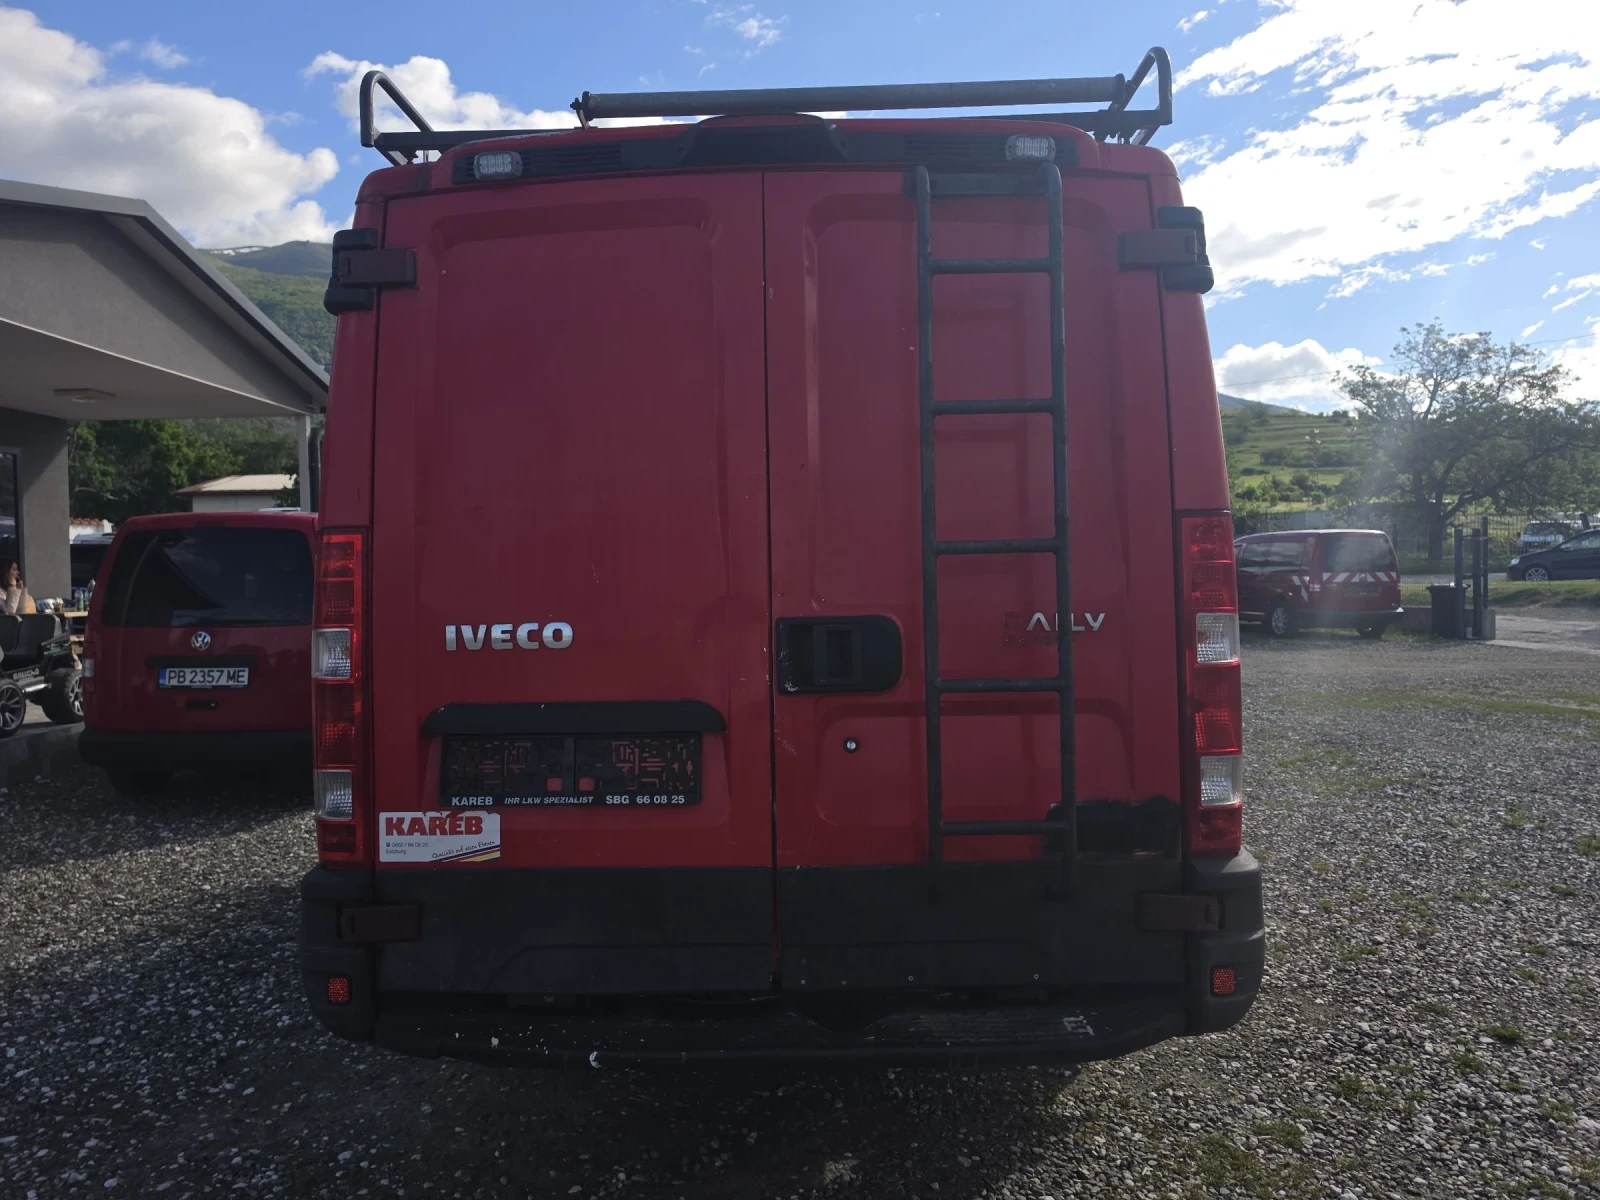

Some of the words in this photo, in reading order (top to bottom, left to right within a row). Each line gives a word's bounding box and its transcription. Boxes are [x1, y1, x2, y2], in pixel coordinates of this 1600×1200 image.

[445, 621, 574, 651] IVECO
[167, 669, 187, 684] PB
[189, 669, 225, 684] 2357
[226, 669, 247, 684] ME
[451, 796, 494, 806] KAREB
[504, 797, 520, 805] IHR
[521, 796, 541, 804] LKW
[543, 795, 594, 804] SPEZIALIST
[605, 794, 630, 805] SBG
[636, 794, 651, 804] 66
[653, 794, 668, 804] 08
[671, 794, 685, 804] 25
[385, 816, 484, 836] KAREB
